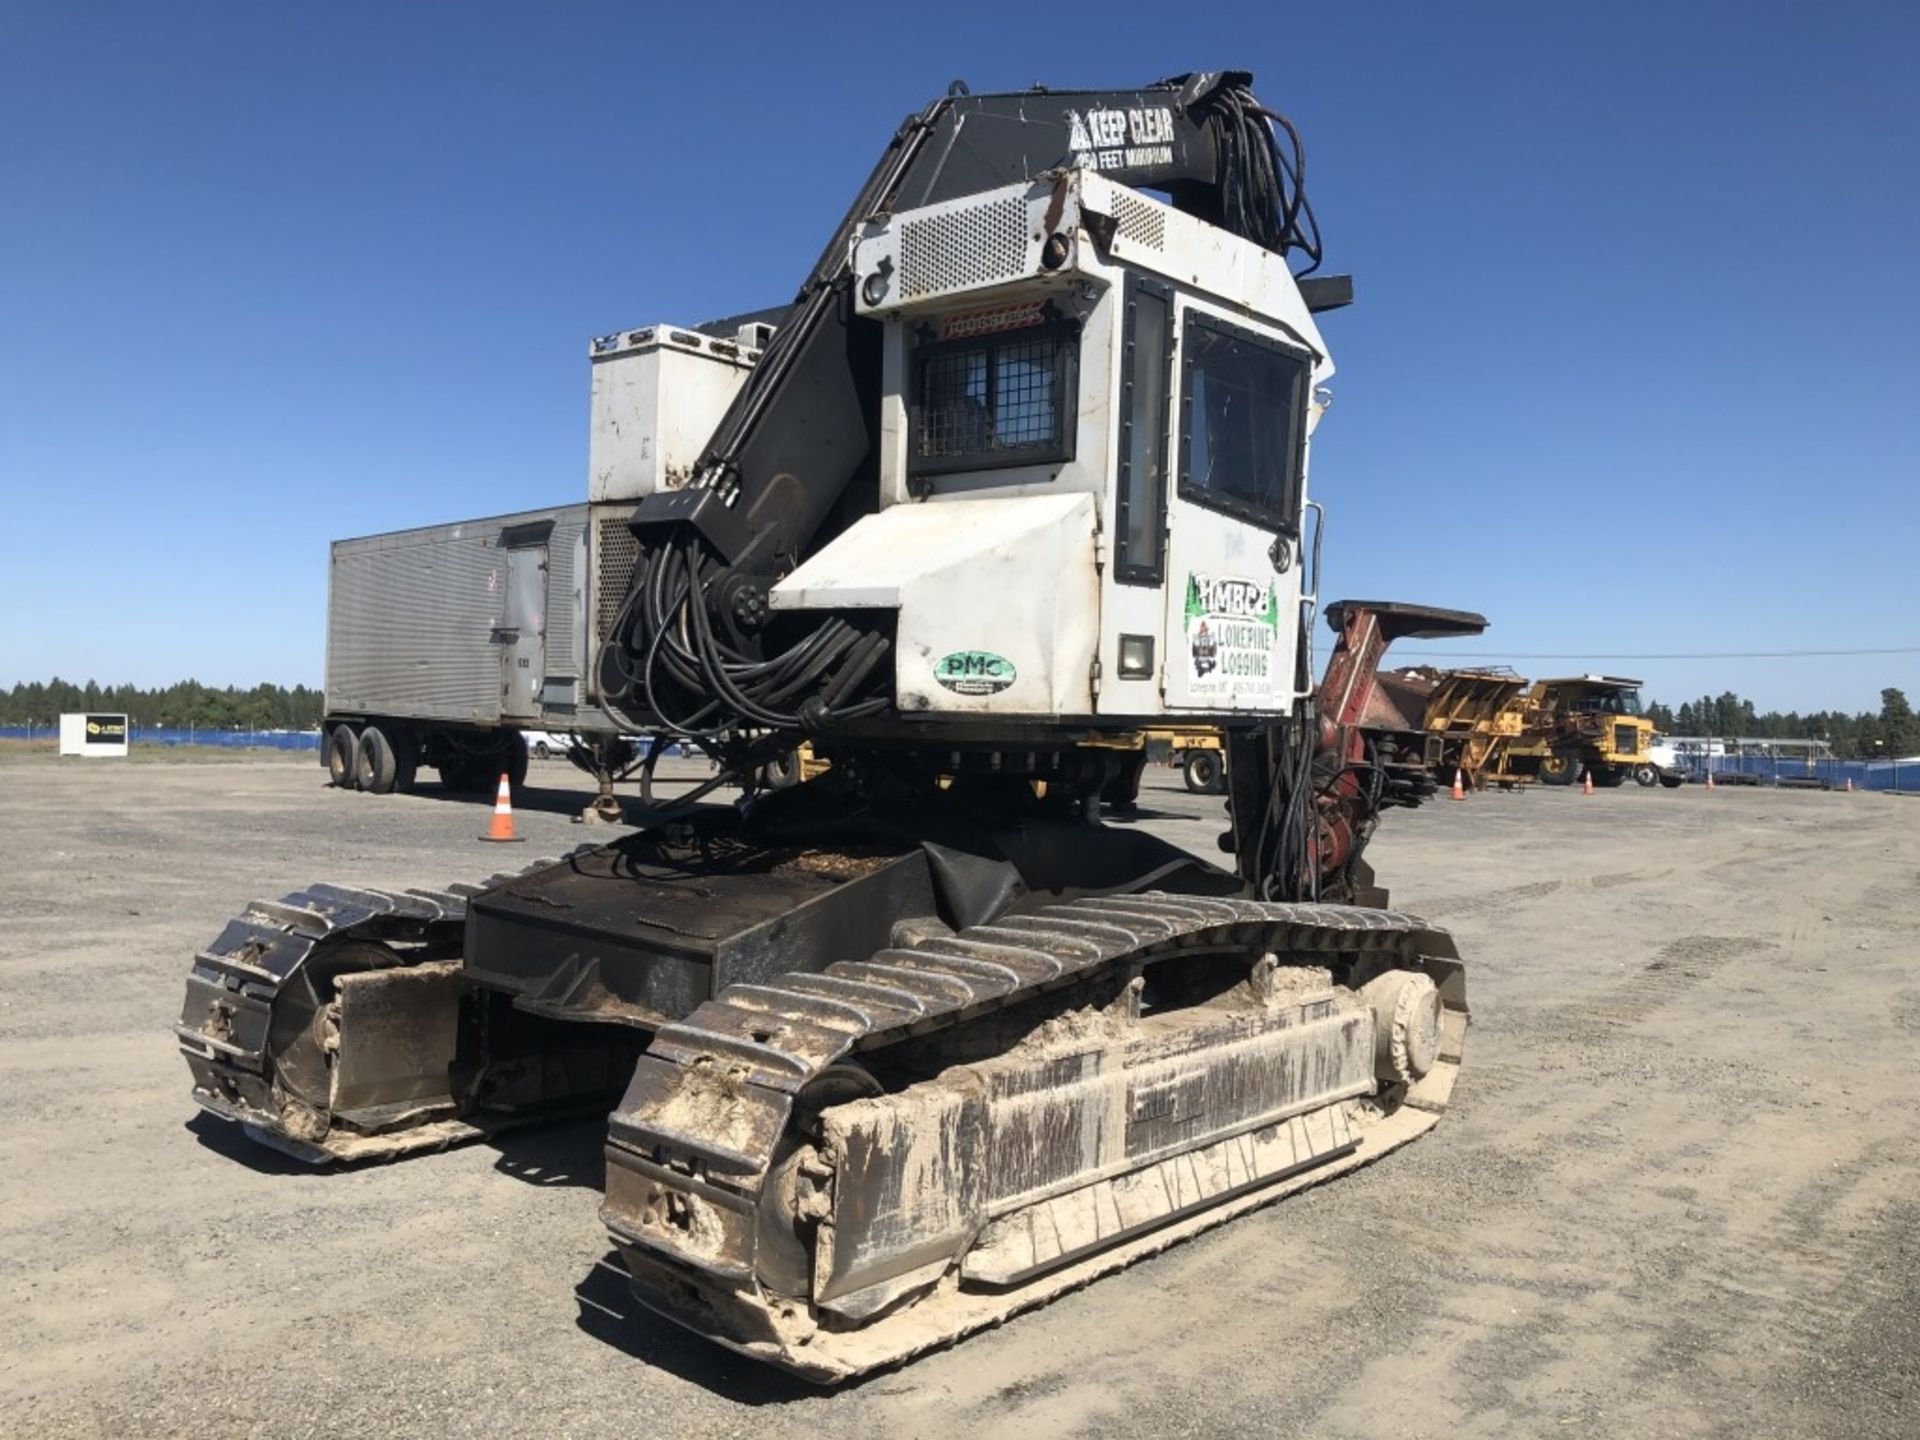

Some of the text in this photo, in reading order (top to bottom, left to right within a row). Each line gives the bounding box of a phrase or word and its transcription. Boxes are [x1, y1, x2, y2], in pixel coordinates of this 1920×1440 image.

[1088, 107, 1175, 147] KEEP CLEAR
[1099, 149, 1124, 169] FEET
[1218, 623, 1271, 651] LONEPINE
[947, 655, 1002, 677] PMC
